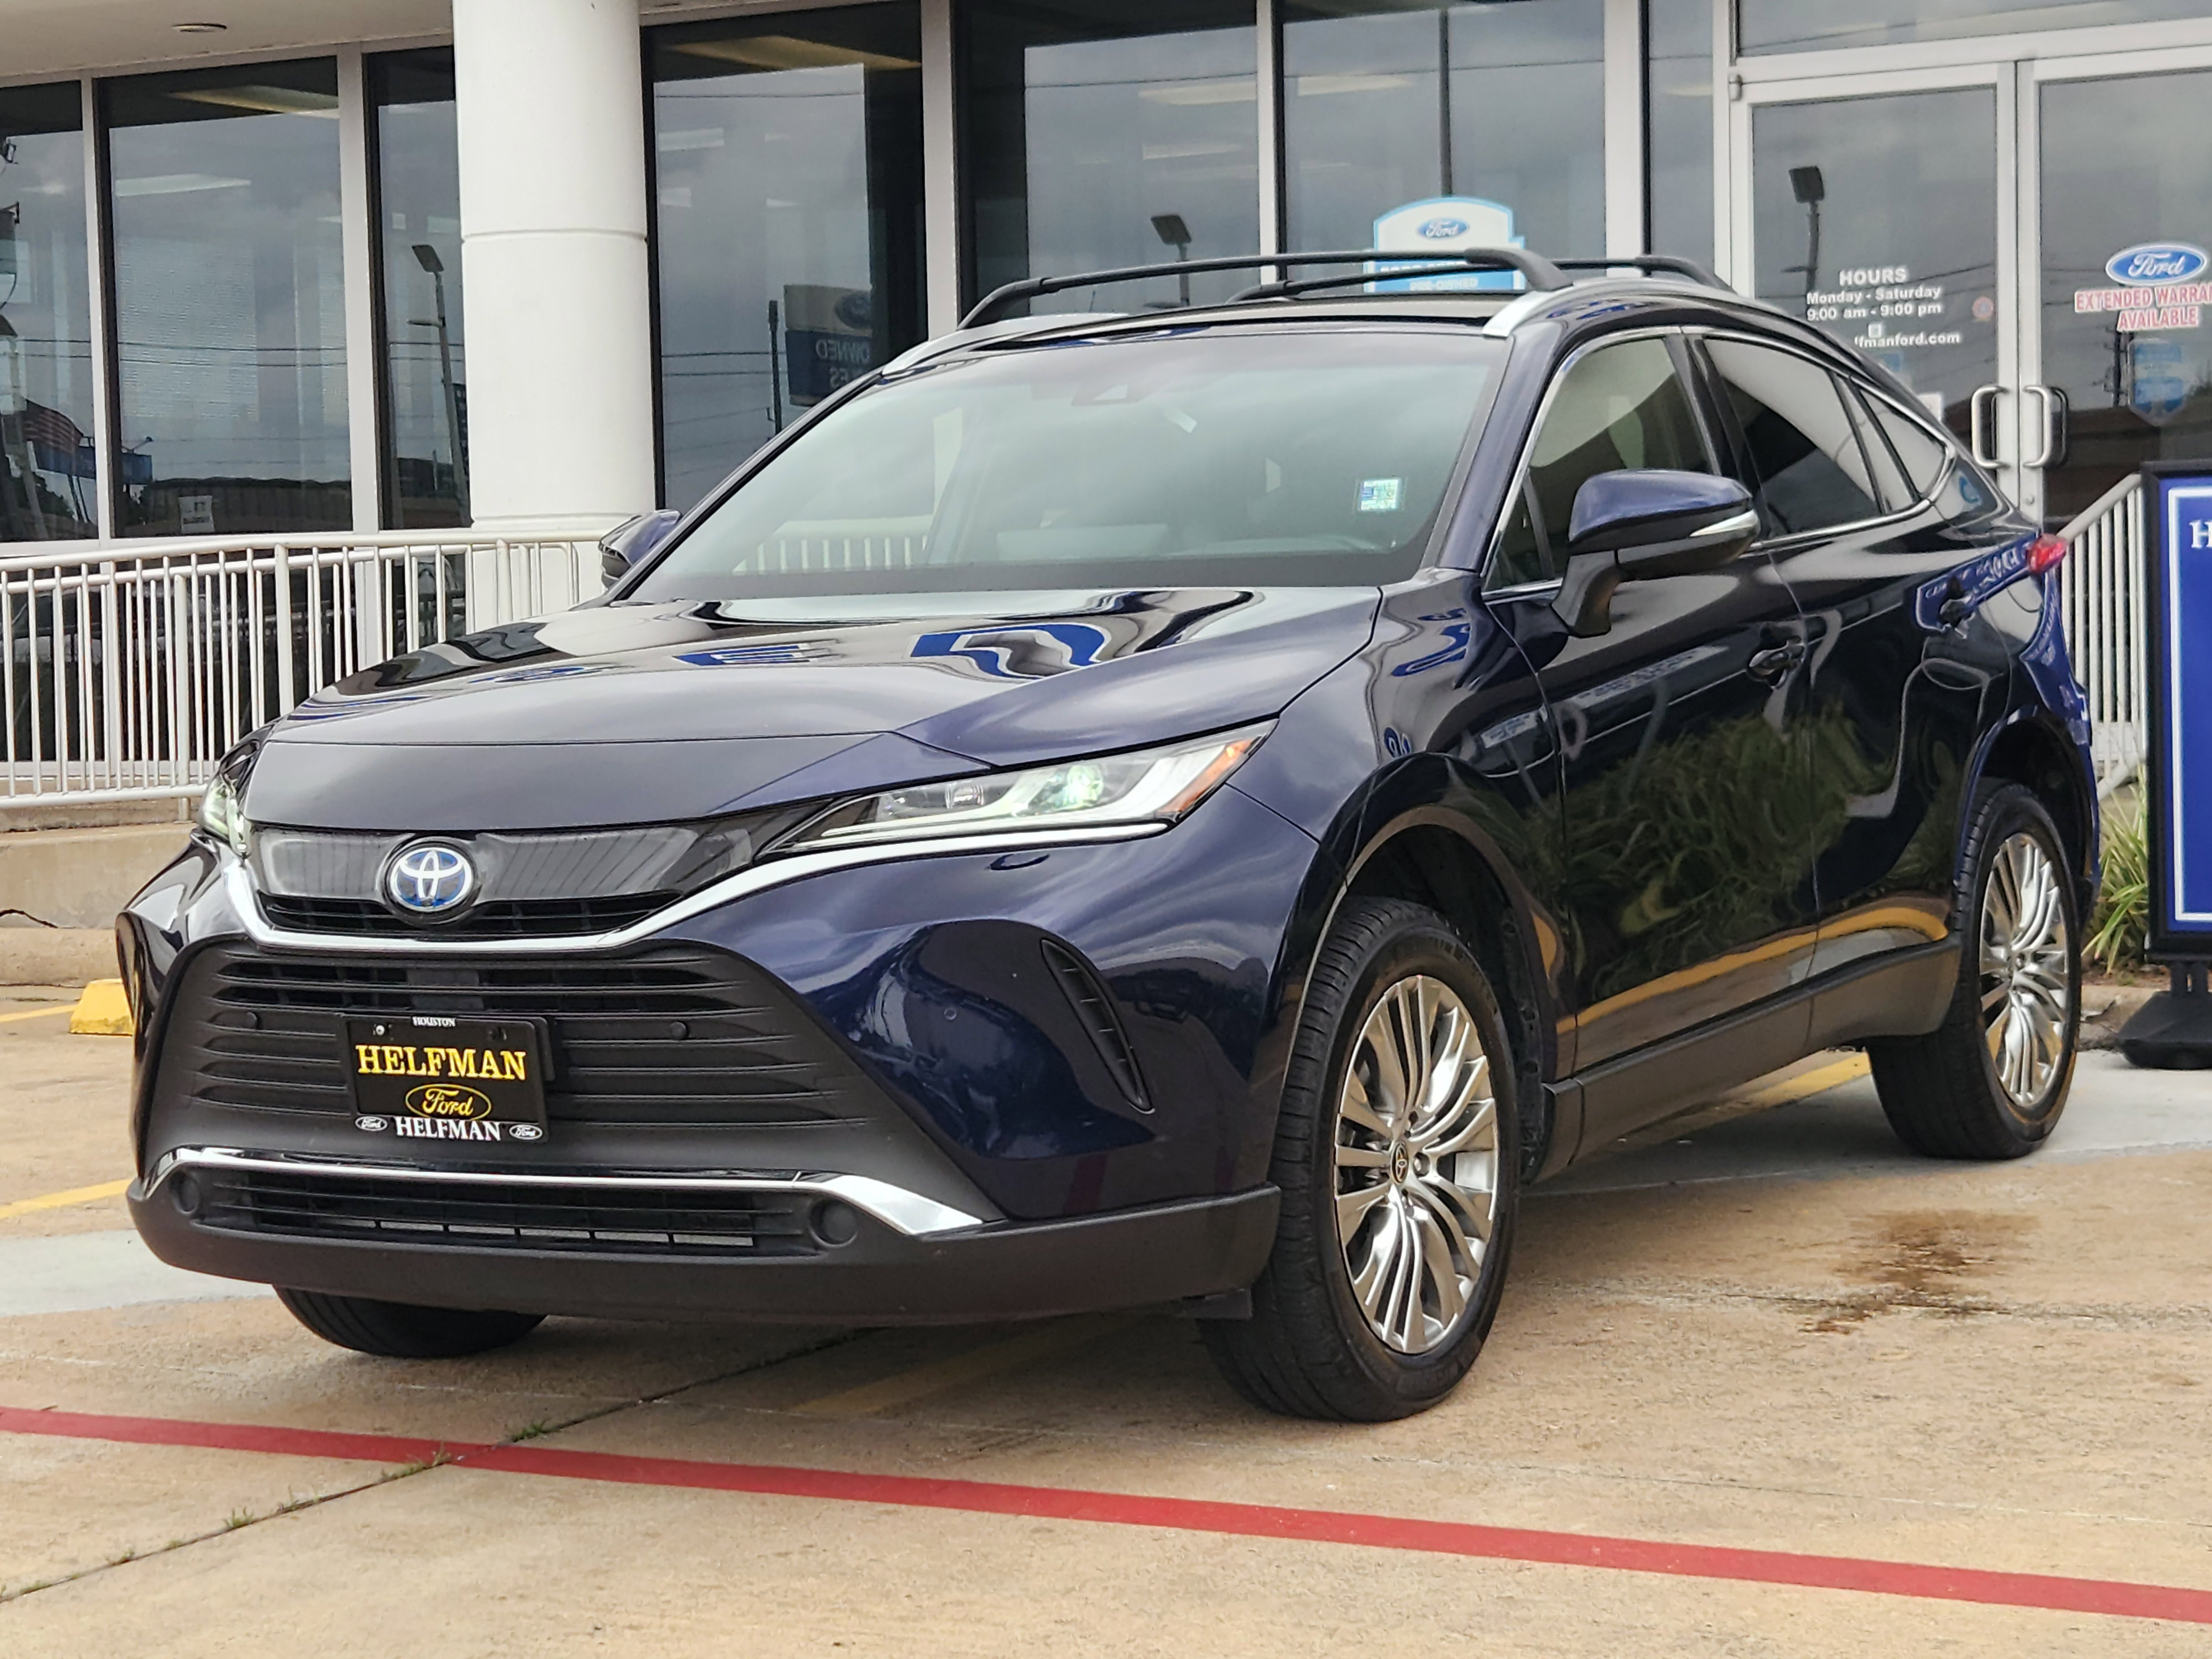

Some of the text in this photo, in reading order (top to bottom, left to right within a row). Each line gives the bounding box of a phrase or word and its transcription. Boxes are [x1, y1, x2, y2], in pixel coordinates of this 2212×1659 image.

[1426, 220, 1459, 238] Ford
[2128, 253, 2186, 276] Ford
[1839, 268, 1907, 286] HOURS
[1807, 291, 1862, 305] Monday
[1875, 286, 1941, 301] Saturday
[2076, 288, 2152, 311] EXTENDED
[1807, 308, 1837, 321] 9:00
[1843, 309, 1866, 319] am
[1881, 303, 1912, 316] 9:00
[1918, 304, 1942, 317] pm
[2119, 307, 2197, 329] AVAILABLE
[412, 1016, 456, 1027] HOUSTON
[355, 1044, 527, 1081] HELFMAN
[423, 1088, 474, 1116] Ford
[361, 1116, 536, 1141] Ford HELFMAN Ford
